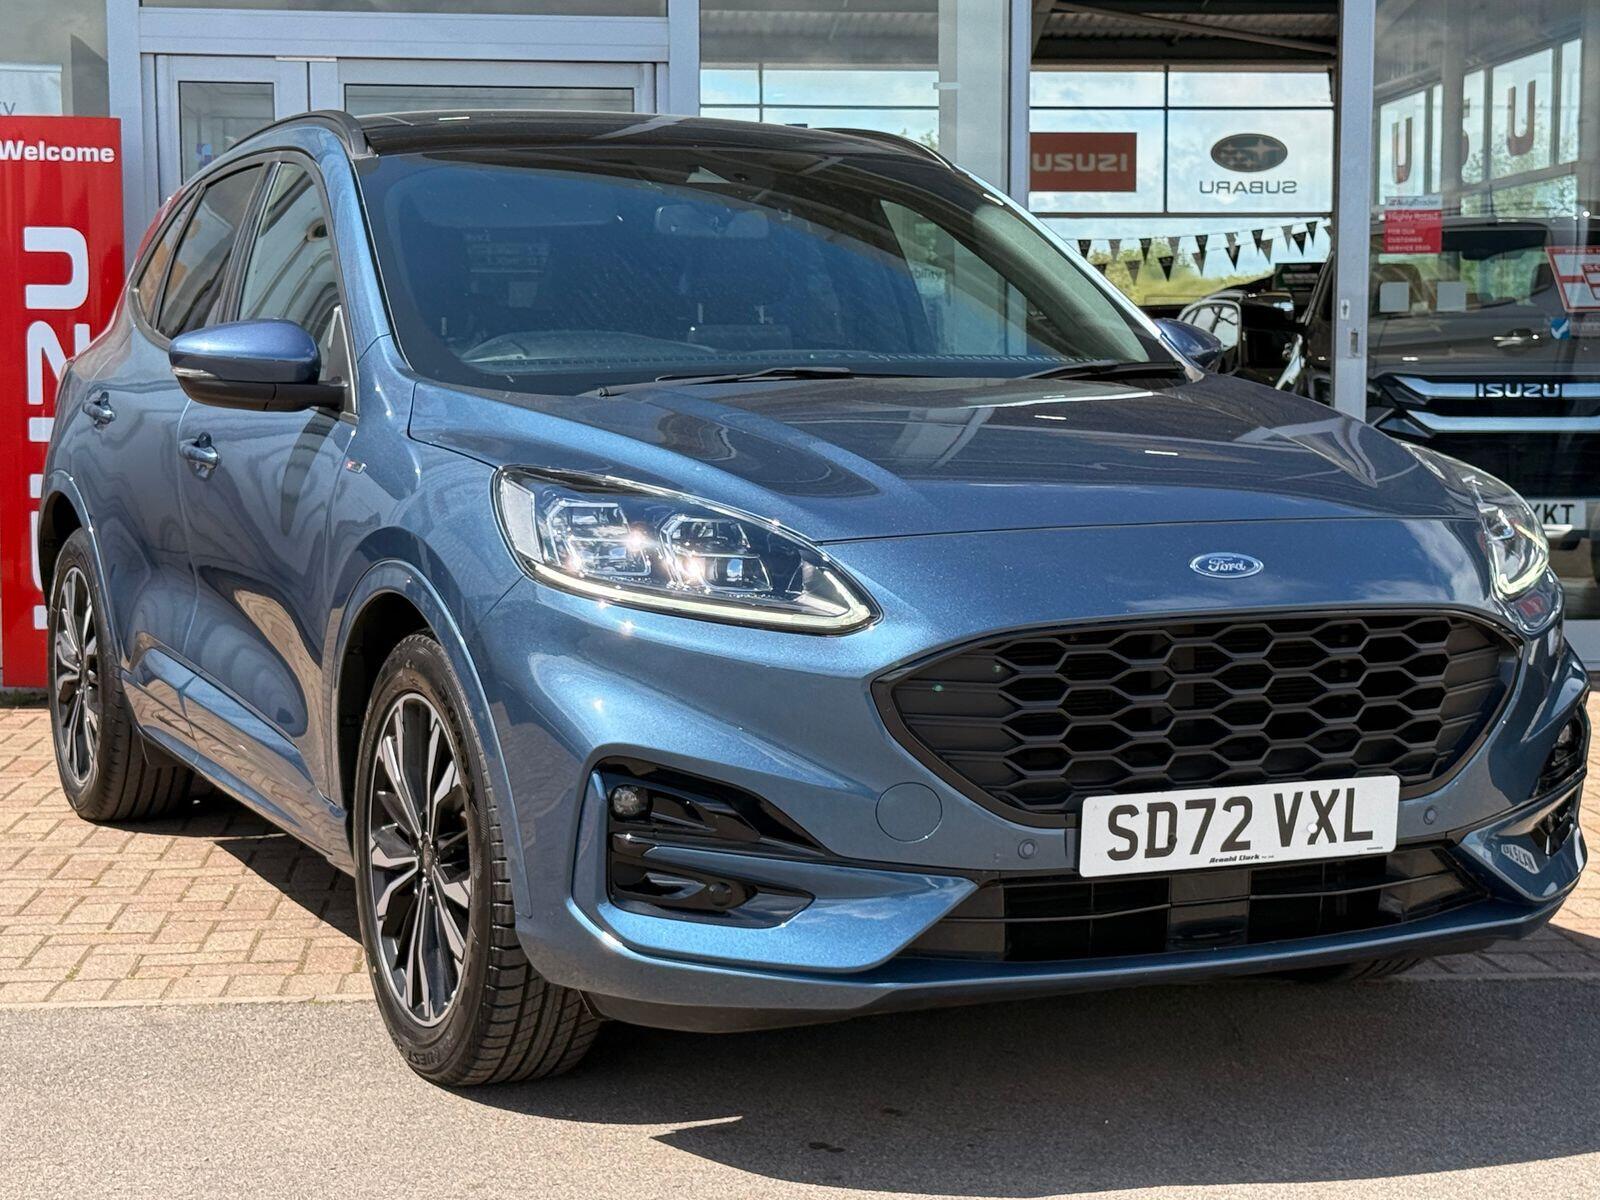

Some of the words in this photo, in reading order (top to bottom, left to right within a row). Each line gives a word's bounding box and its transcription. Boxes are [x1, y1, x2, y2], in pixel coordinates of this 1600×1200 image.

[0, 140, 115, 163] Welcome
[1478, 383, 1561, 397] ISUZU
[1107, 796, 1253, 861] SD72
[1274, 788, 1373, 847] VXL
